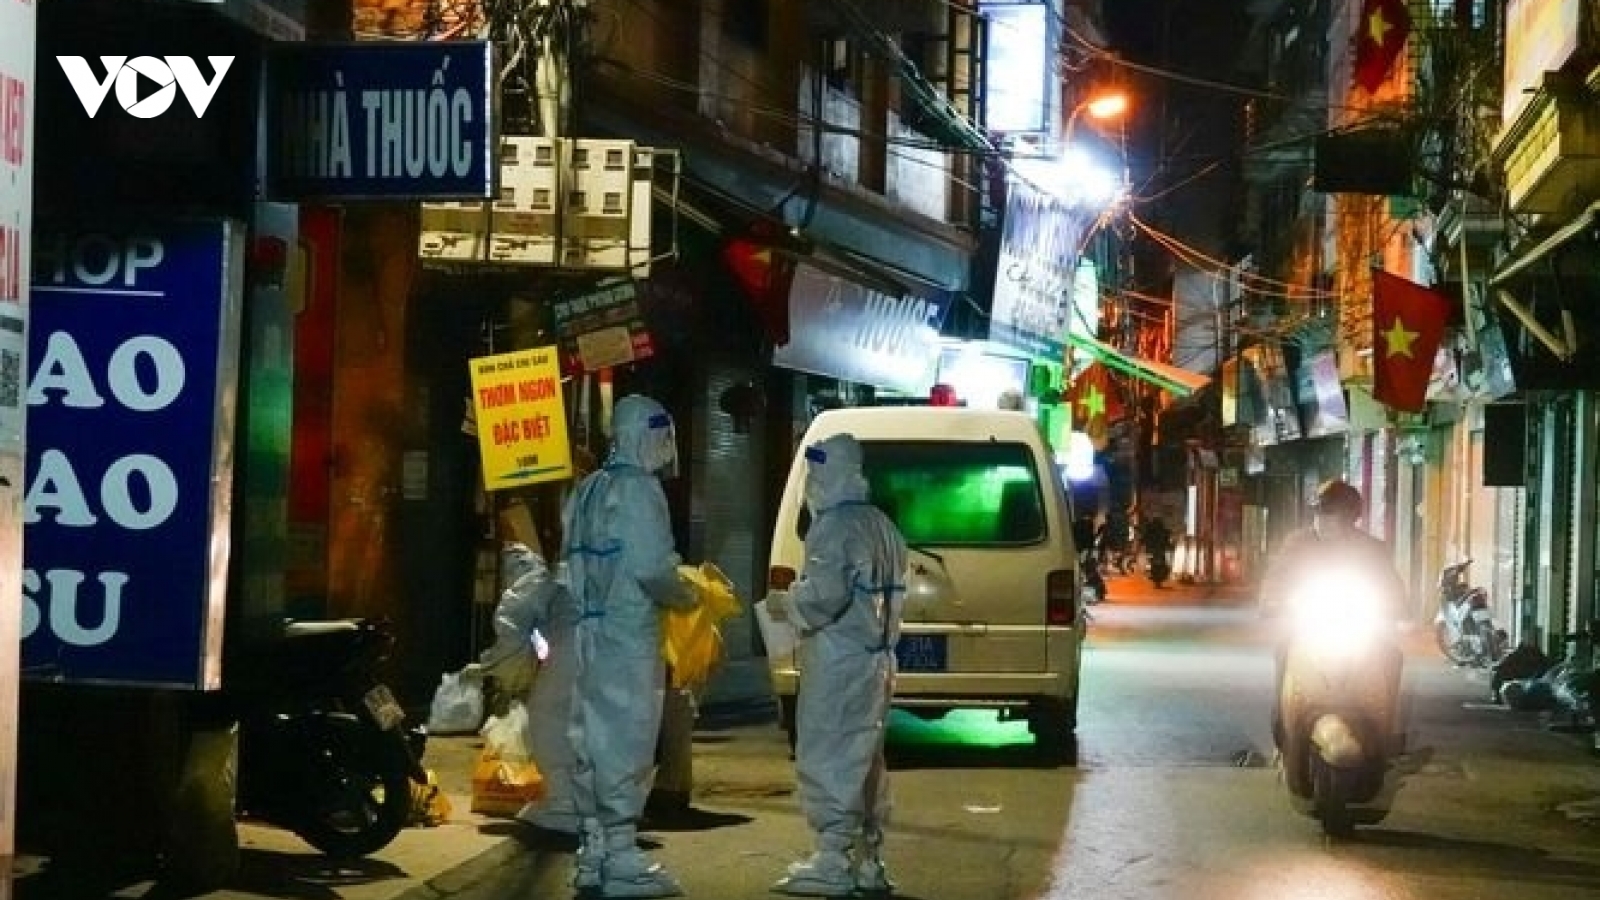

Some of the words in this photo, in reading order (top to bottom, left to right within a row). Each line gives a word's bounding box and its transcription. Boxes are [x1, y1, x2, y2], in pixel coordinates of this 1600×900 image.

[362, 55, 473, 178] THUỐC
[518, 376, 556, 402] NGON
[522, 411, 551, 442] BIỆT
